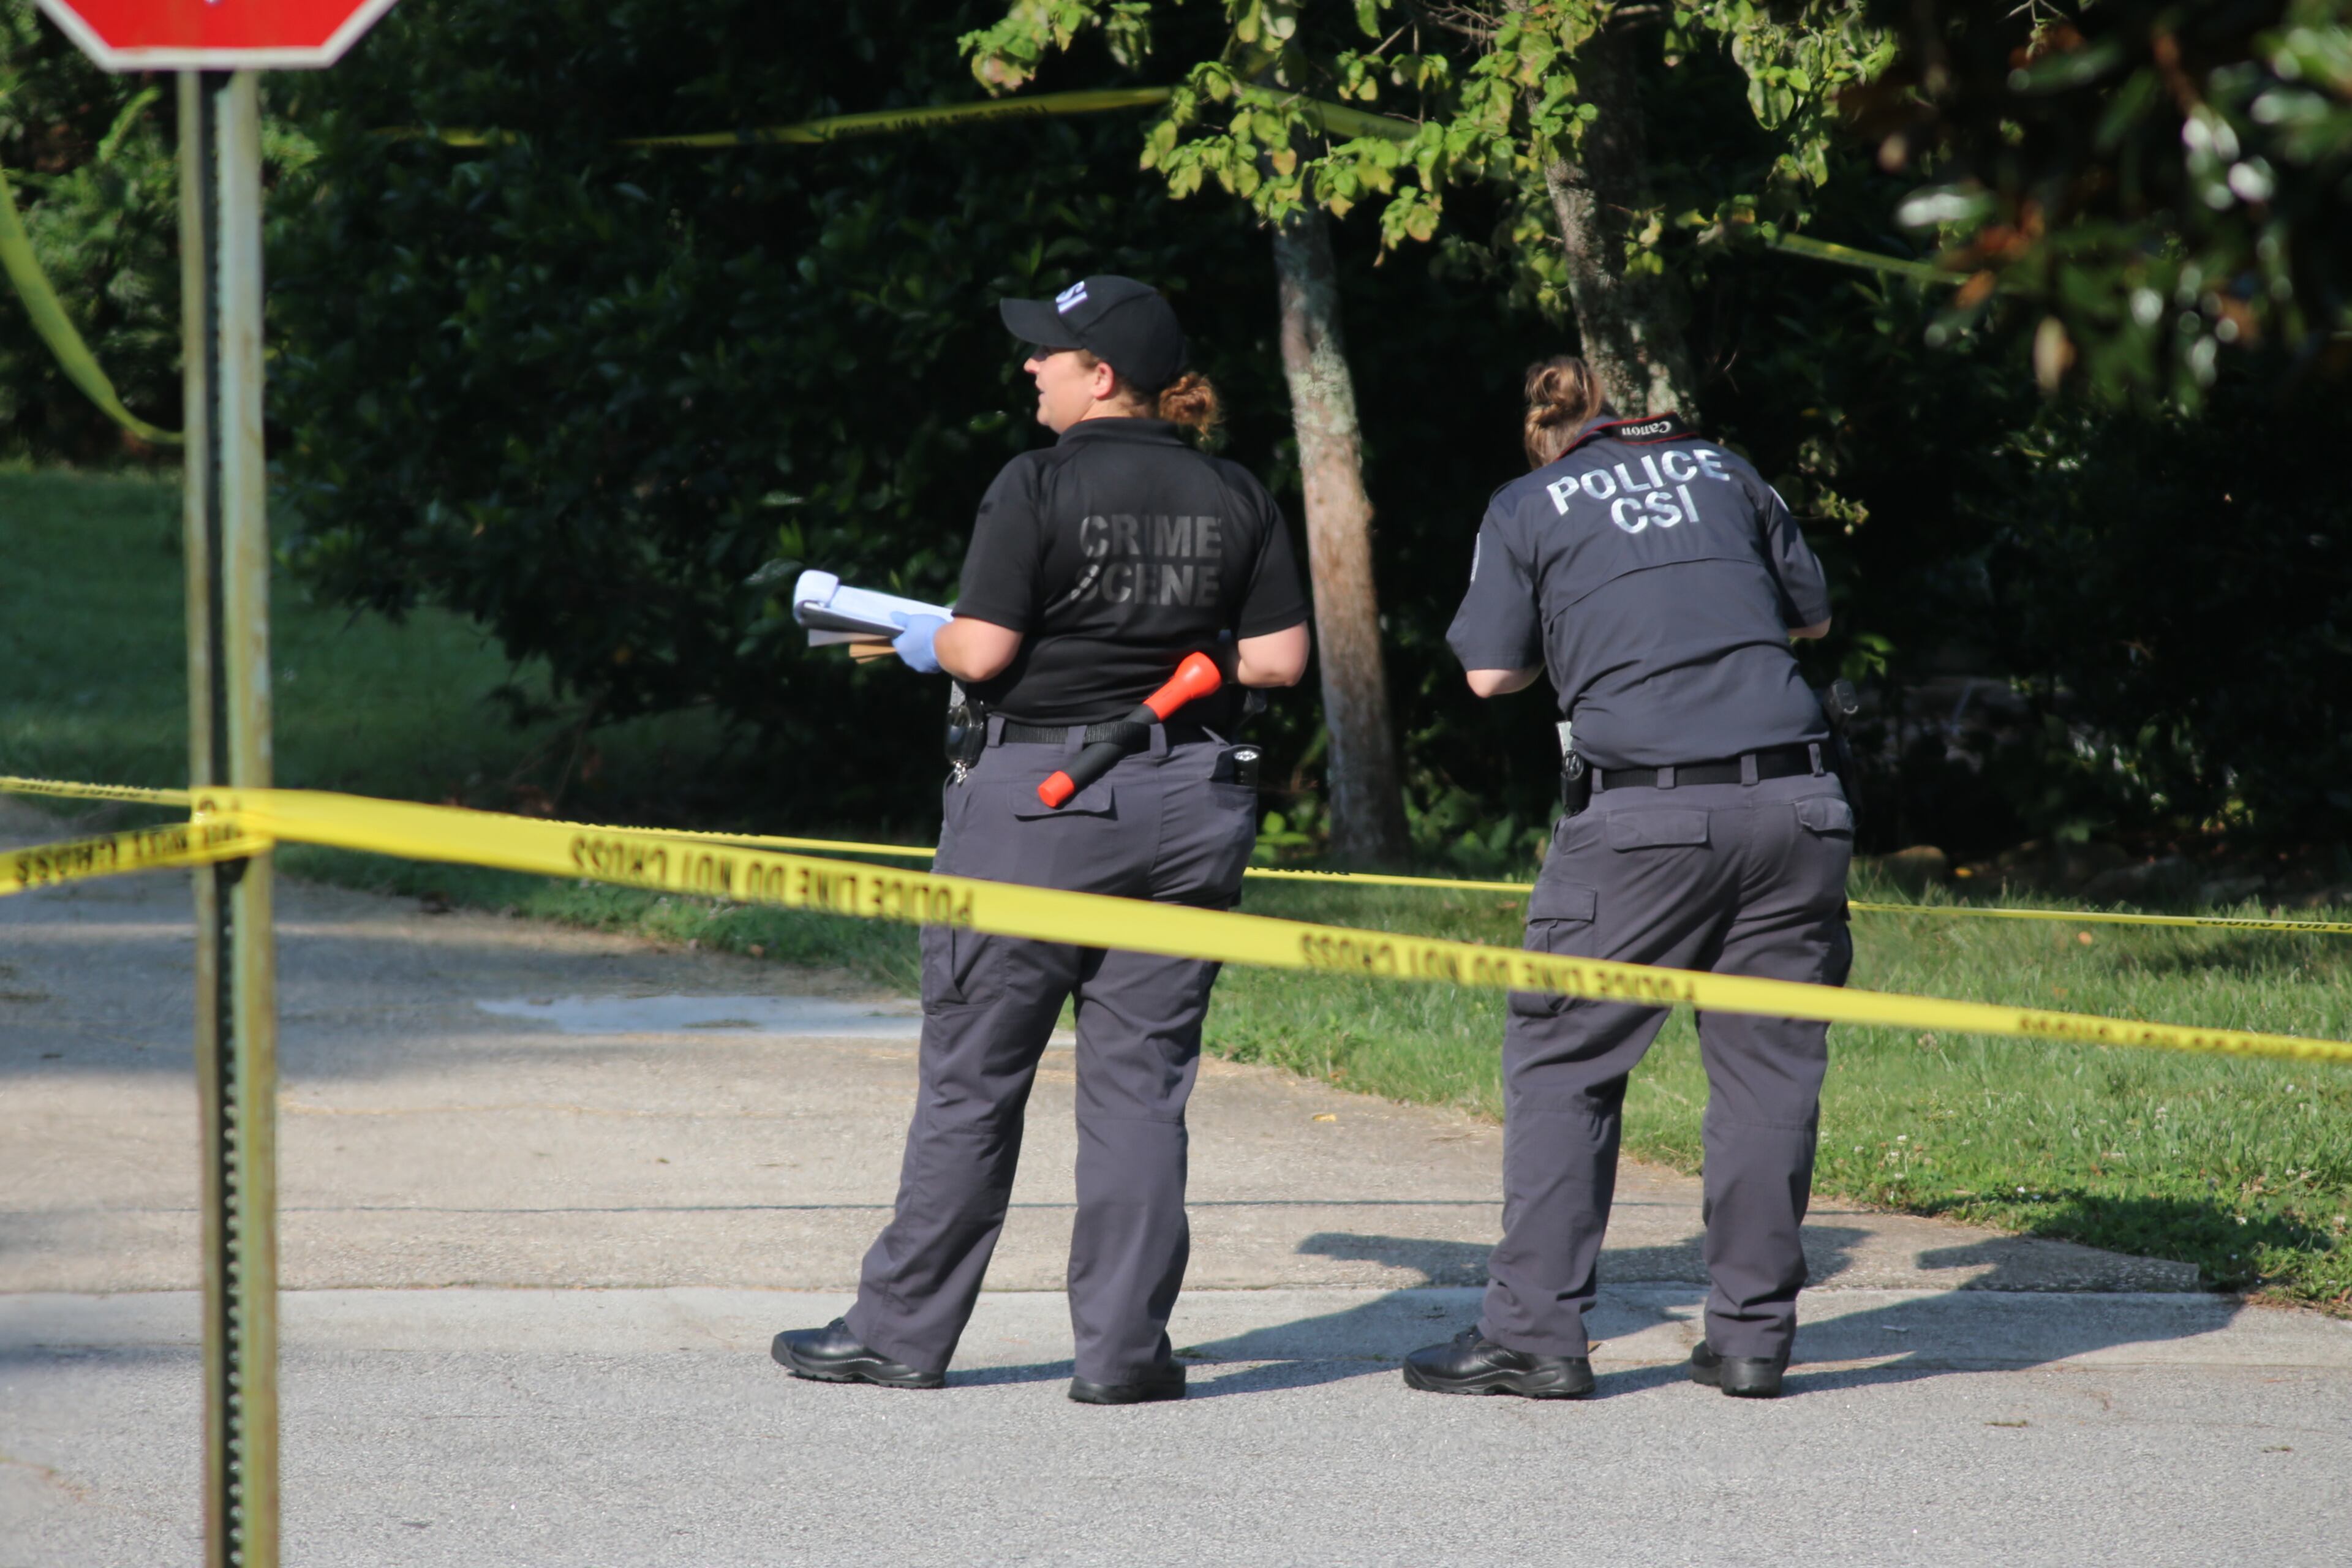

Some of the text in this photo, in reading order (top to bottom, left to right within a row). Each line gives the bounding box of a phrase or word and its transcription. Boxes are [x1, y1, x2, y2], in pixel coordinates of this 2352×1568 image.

[1621, 420, 1672, 437] Canon
[1546, 448, 1731, 516] POLICE
[1610, 484, 1700, 534] CSI
[1079, 513, 1222, 558] CRIME
